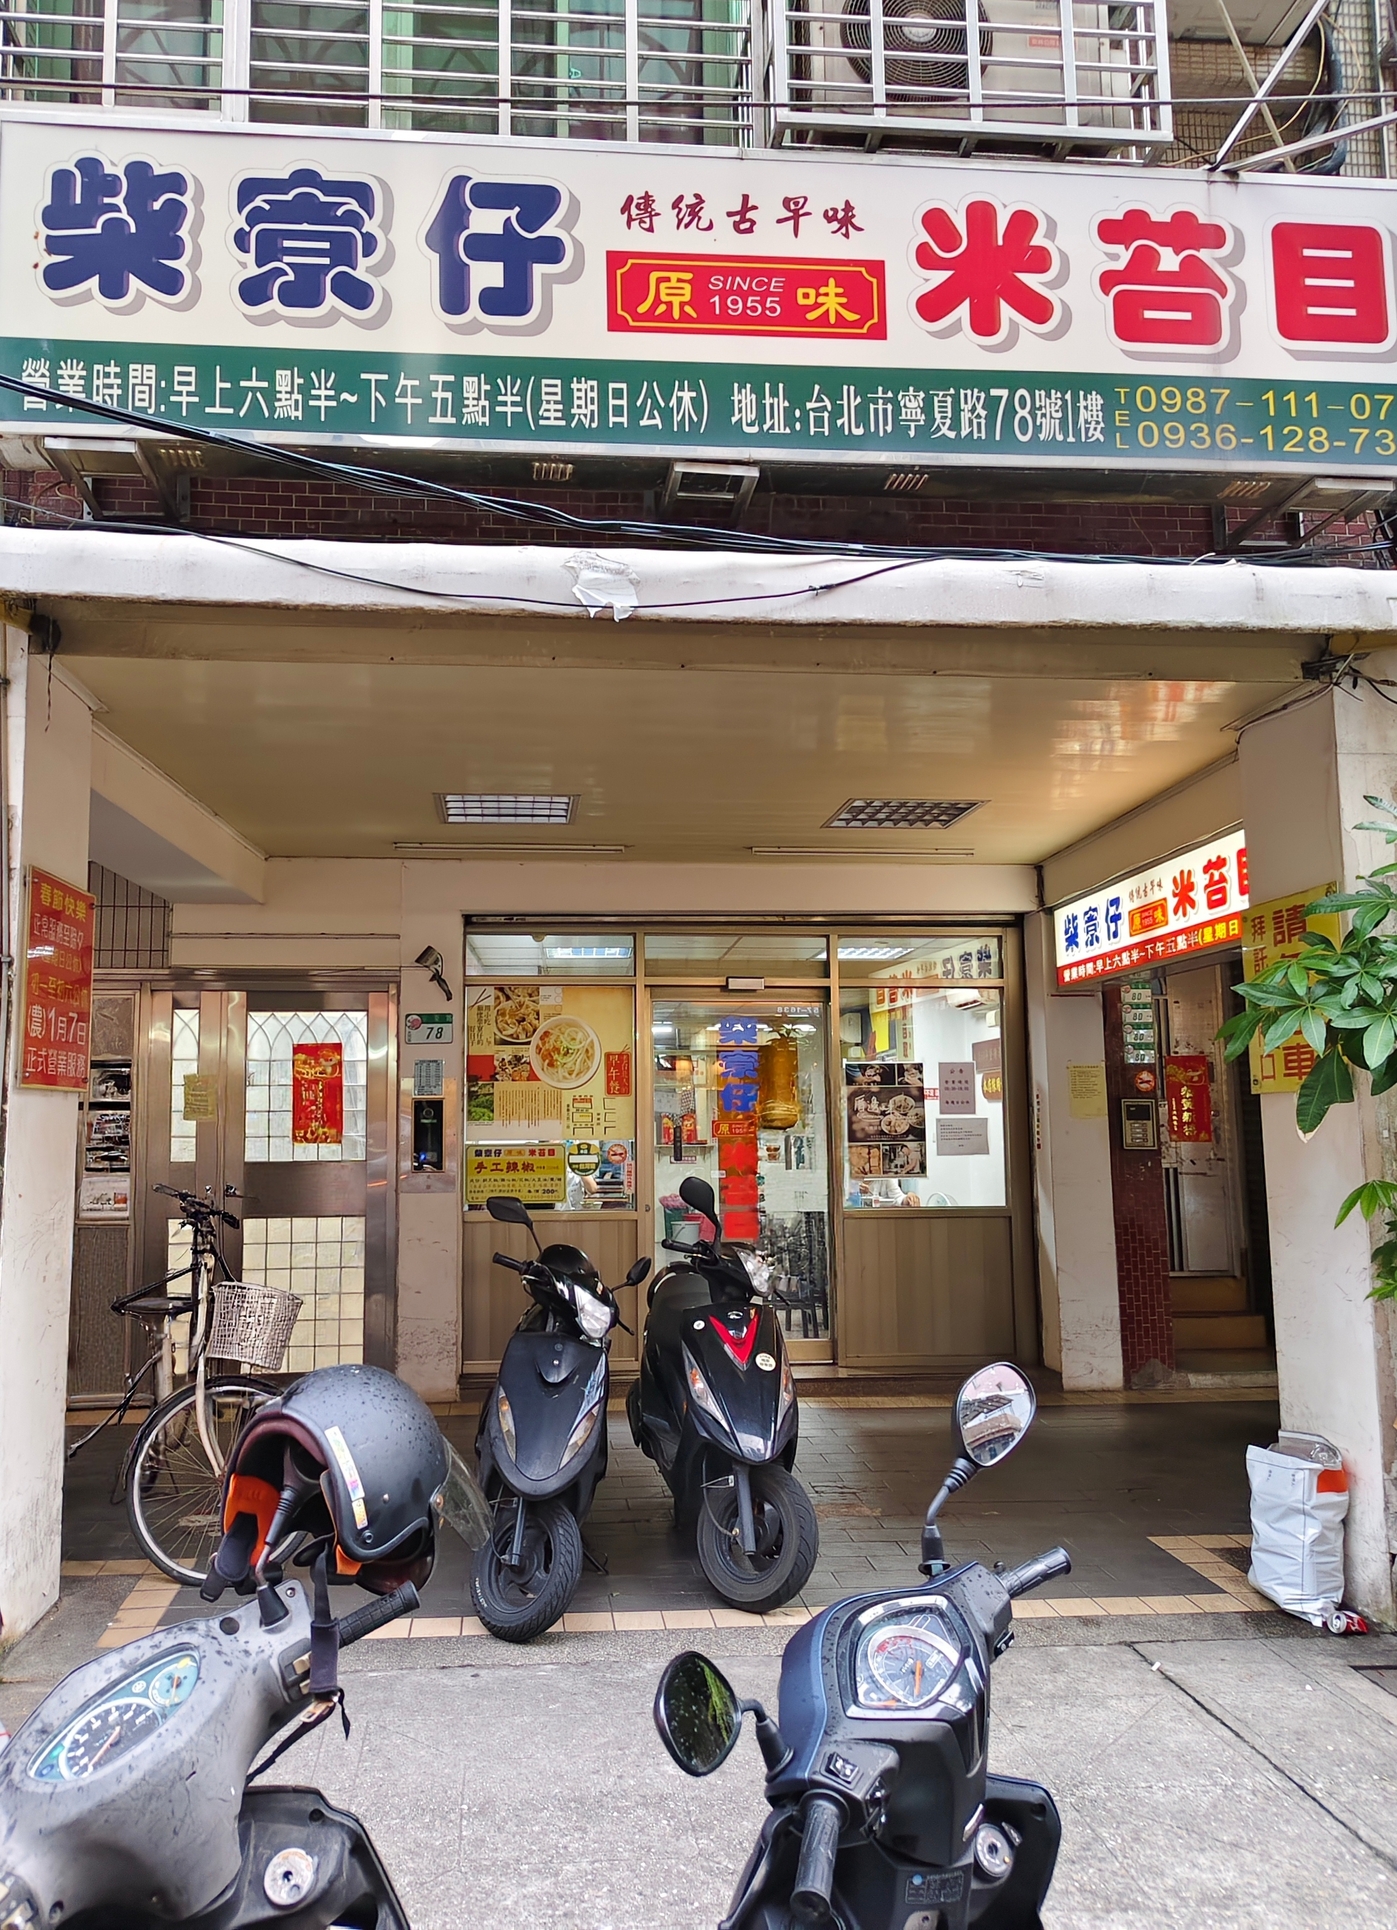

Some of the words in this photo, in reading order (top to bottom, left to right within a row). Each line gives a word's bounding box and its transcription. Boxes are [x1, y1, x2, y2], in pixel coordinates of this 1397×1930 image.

[620, 190, 865, 240] 傳統古早味
[915, 200, 1389, 344] 米苔目
[708, 275, 786, 292] SINCE
[636, 271, 697, 320] 原
[796, 277, 861, 324] 味
[709, 294, 781, 317] 1955
[40, 882, 86, 922] 春節快樂
[1133, 1013, 1143, 1021] 80
[426, 1026, 444, 1040] 78
[1134, 1033, 1144, 1041] 80
[26, 1046, 86, 1077] 正式營業服務
[1135, 1054, 1146, 1062] 80
[474, 1161, 536, 1174] 手工辣椒
